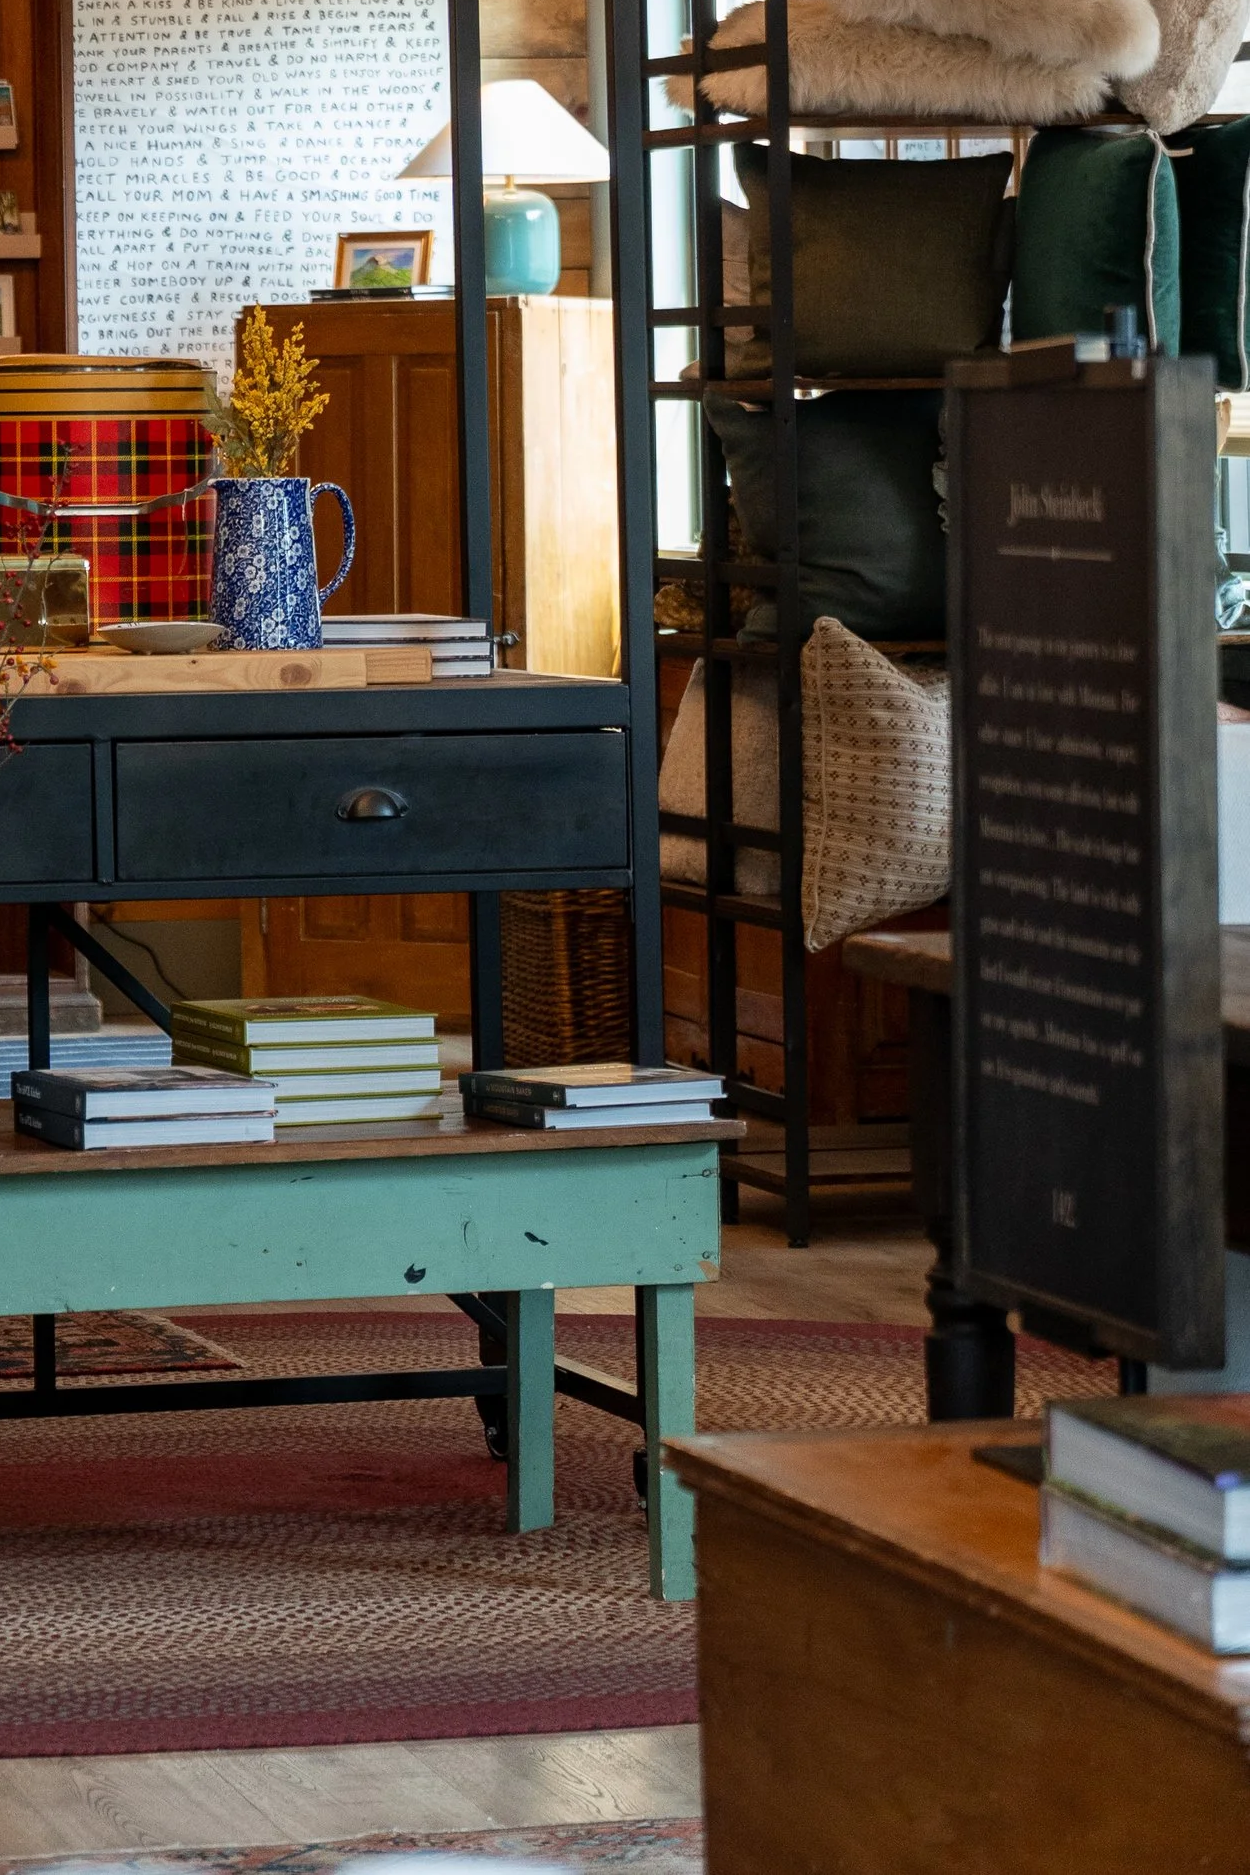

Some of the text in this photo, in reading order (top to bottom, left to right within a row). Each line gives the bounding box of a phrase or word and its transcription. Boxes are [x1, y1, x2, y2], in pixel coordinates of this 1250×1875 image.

[127, 0, 136, 9] A
[143, 0, 171, 9] KISS
[184, 0, 190, 8] &
[198, 0, 212, 9] BE
[75, 189, 439, 203] CALL YOUR MOM & HAVE A SMASHING GOOD TIME
[75, 290, 309, 306] HAVE COURAGE & RESCUE DOGS
